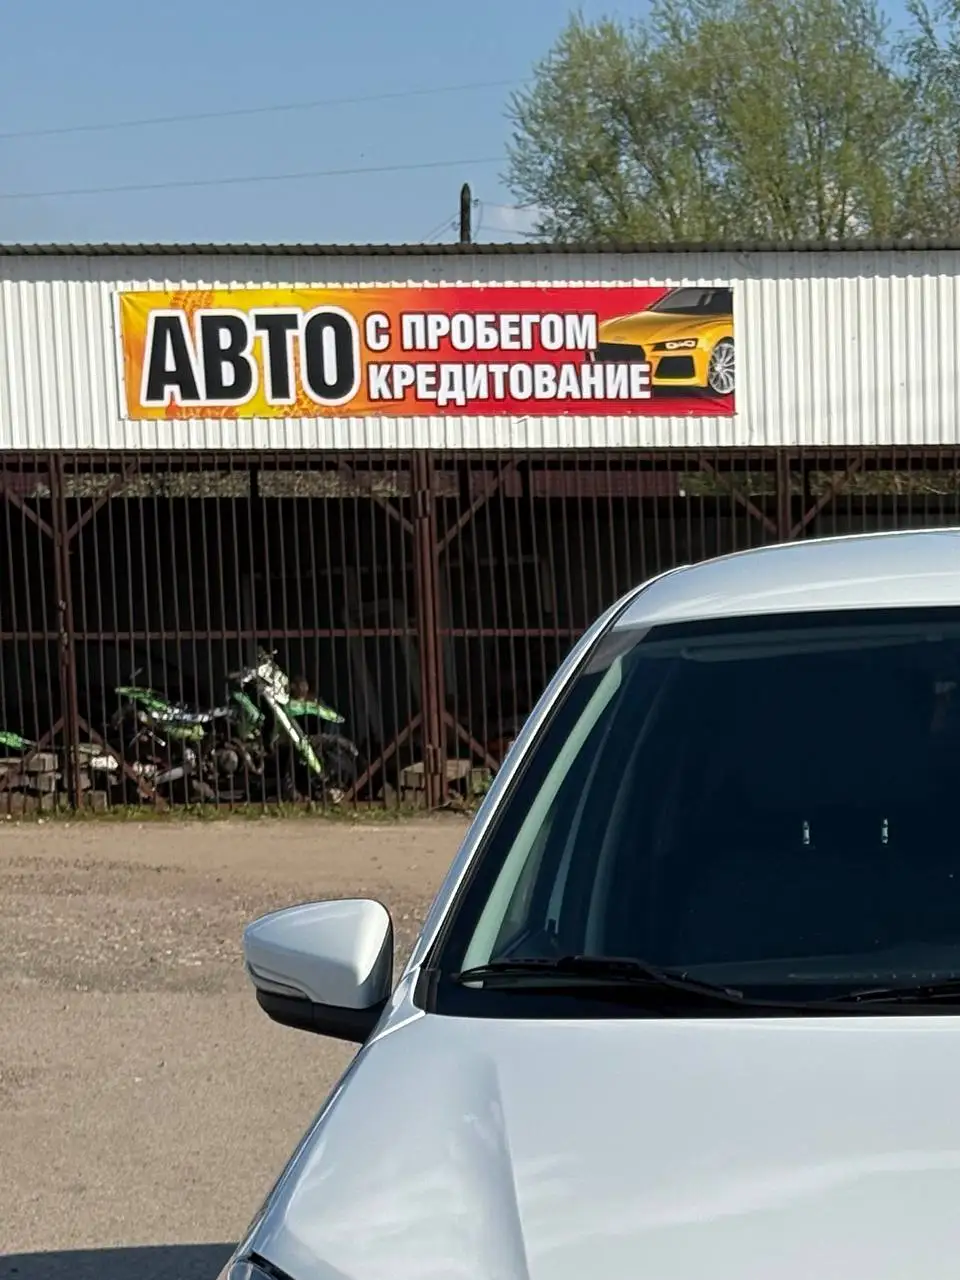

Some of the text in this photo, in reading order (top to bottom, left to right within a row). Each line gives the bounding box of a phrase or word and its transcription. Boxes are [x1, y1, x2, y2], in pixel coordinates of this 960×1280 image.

[367, 314, 597, 350] С ПРОБЕГОМ
[142, 307, 357, 404] АВТО
[369, 363, 650, 406] КРЕДИТОВАНИЕ
